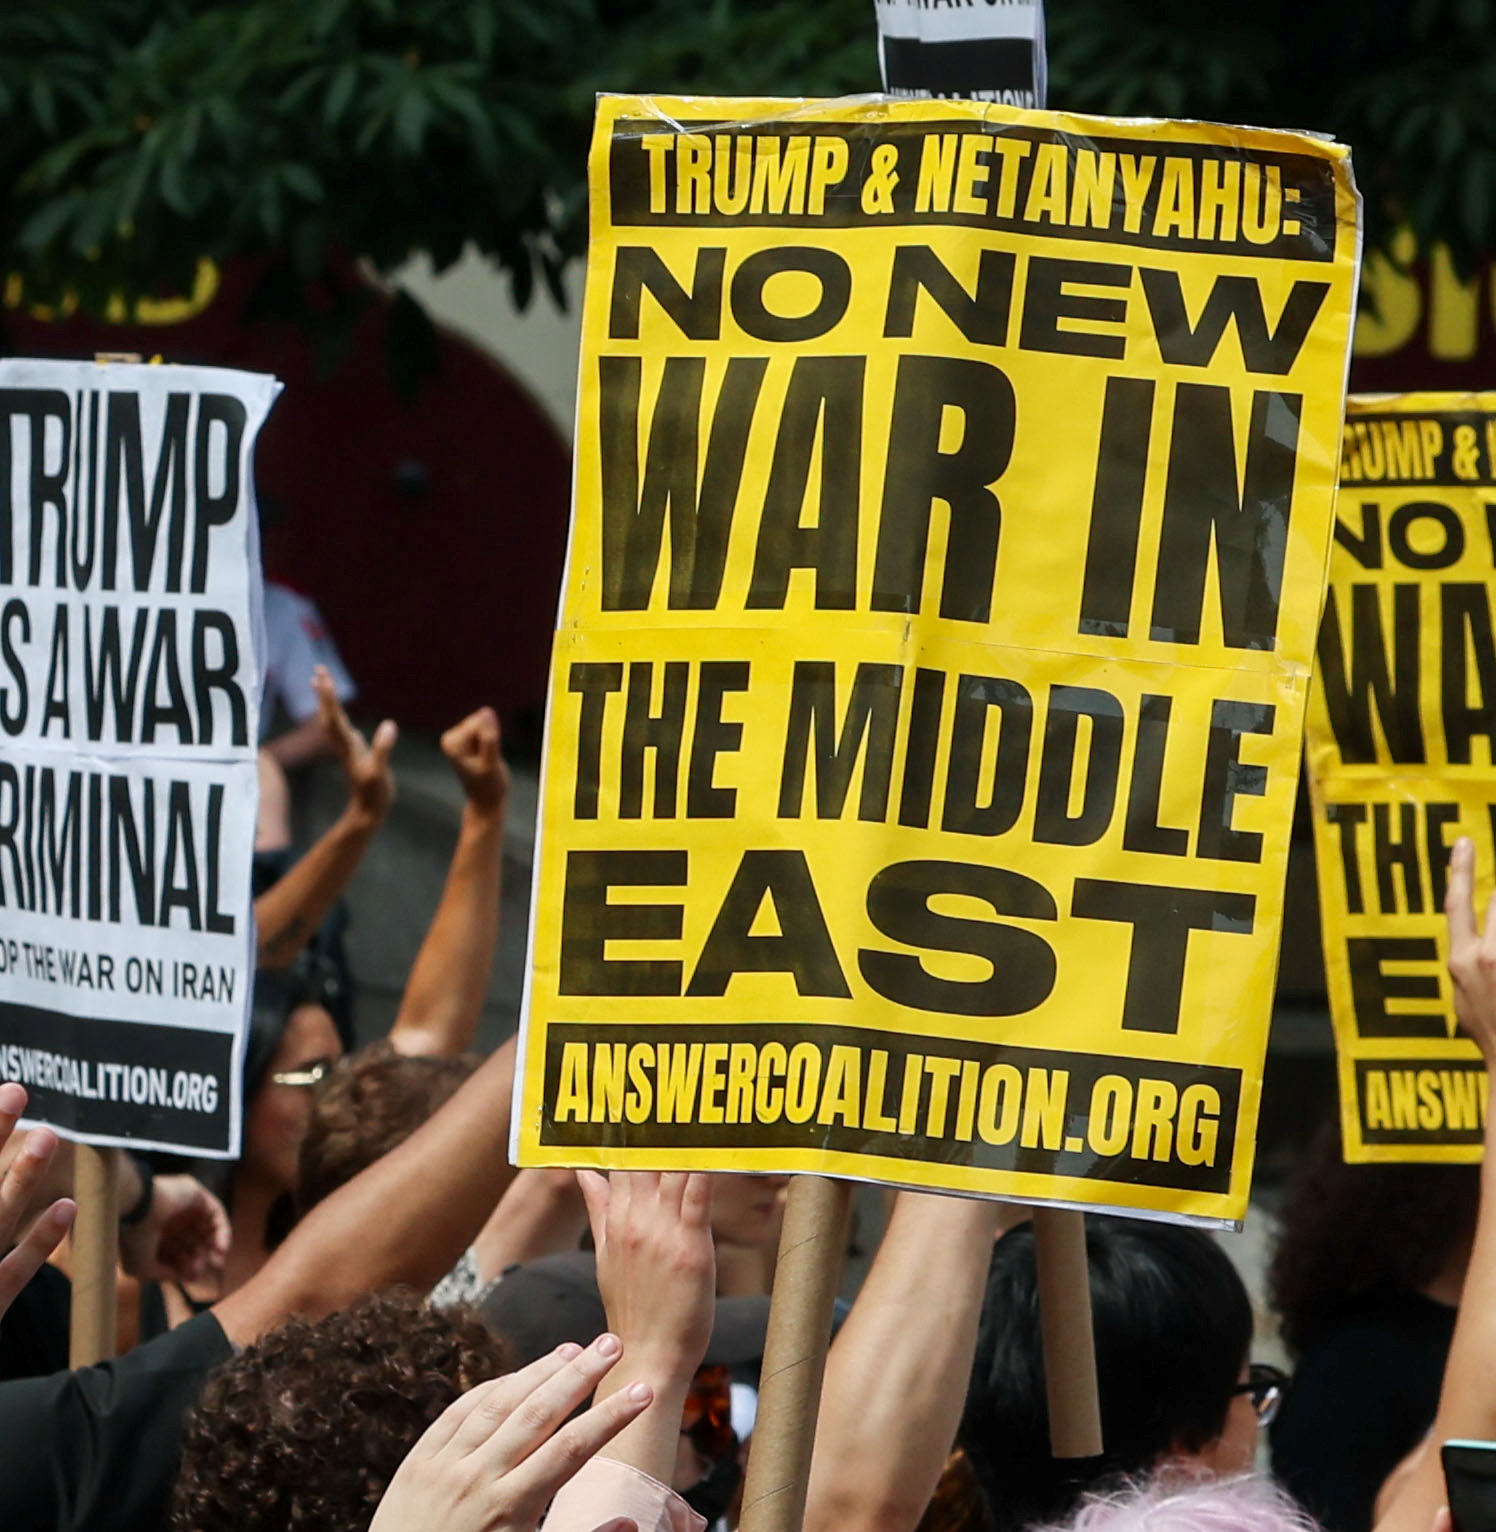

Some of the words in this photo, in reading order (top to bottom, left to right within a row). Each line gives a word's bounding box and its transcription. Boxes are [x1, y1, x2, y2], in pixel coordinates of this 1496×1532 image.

[641, 134, 848, 216] TRUMP
[861, 143, 900, 215] &
[914, 134, 1301, 246] NETANYAHU:
[608, 246, 852, 343] NO
[883, 244, 1332, 376] NEW
[598, 353, 1018, 625] WAR
[1078, 375, 1304, 653] IN
[1341, 420, 1443, 481] RUMP
[1452, 425, 1480, 480] &
[41, 603, 71, 739] A
[84, 603, 250, 746] WAR
[568, 660, 750, 821] THE
[776, 660, 1276, 864] MIDDLE
[24, 943, 57, 983] THE
[58, 949, 115, 992] WAR
[125, 956, 163, 996] ON
[173, 962, 236, 1004] IRAN
[558, 850, 1257, 1036] EAST
[554, 1041, 1221, 1169] ANSWERCOALITION.ORG
